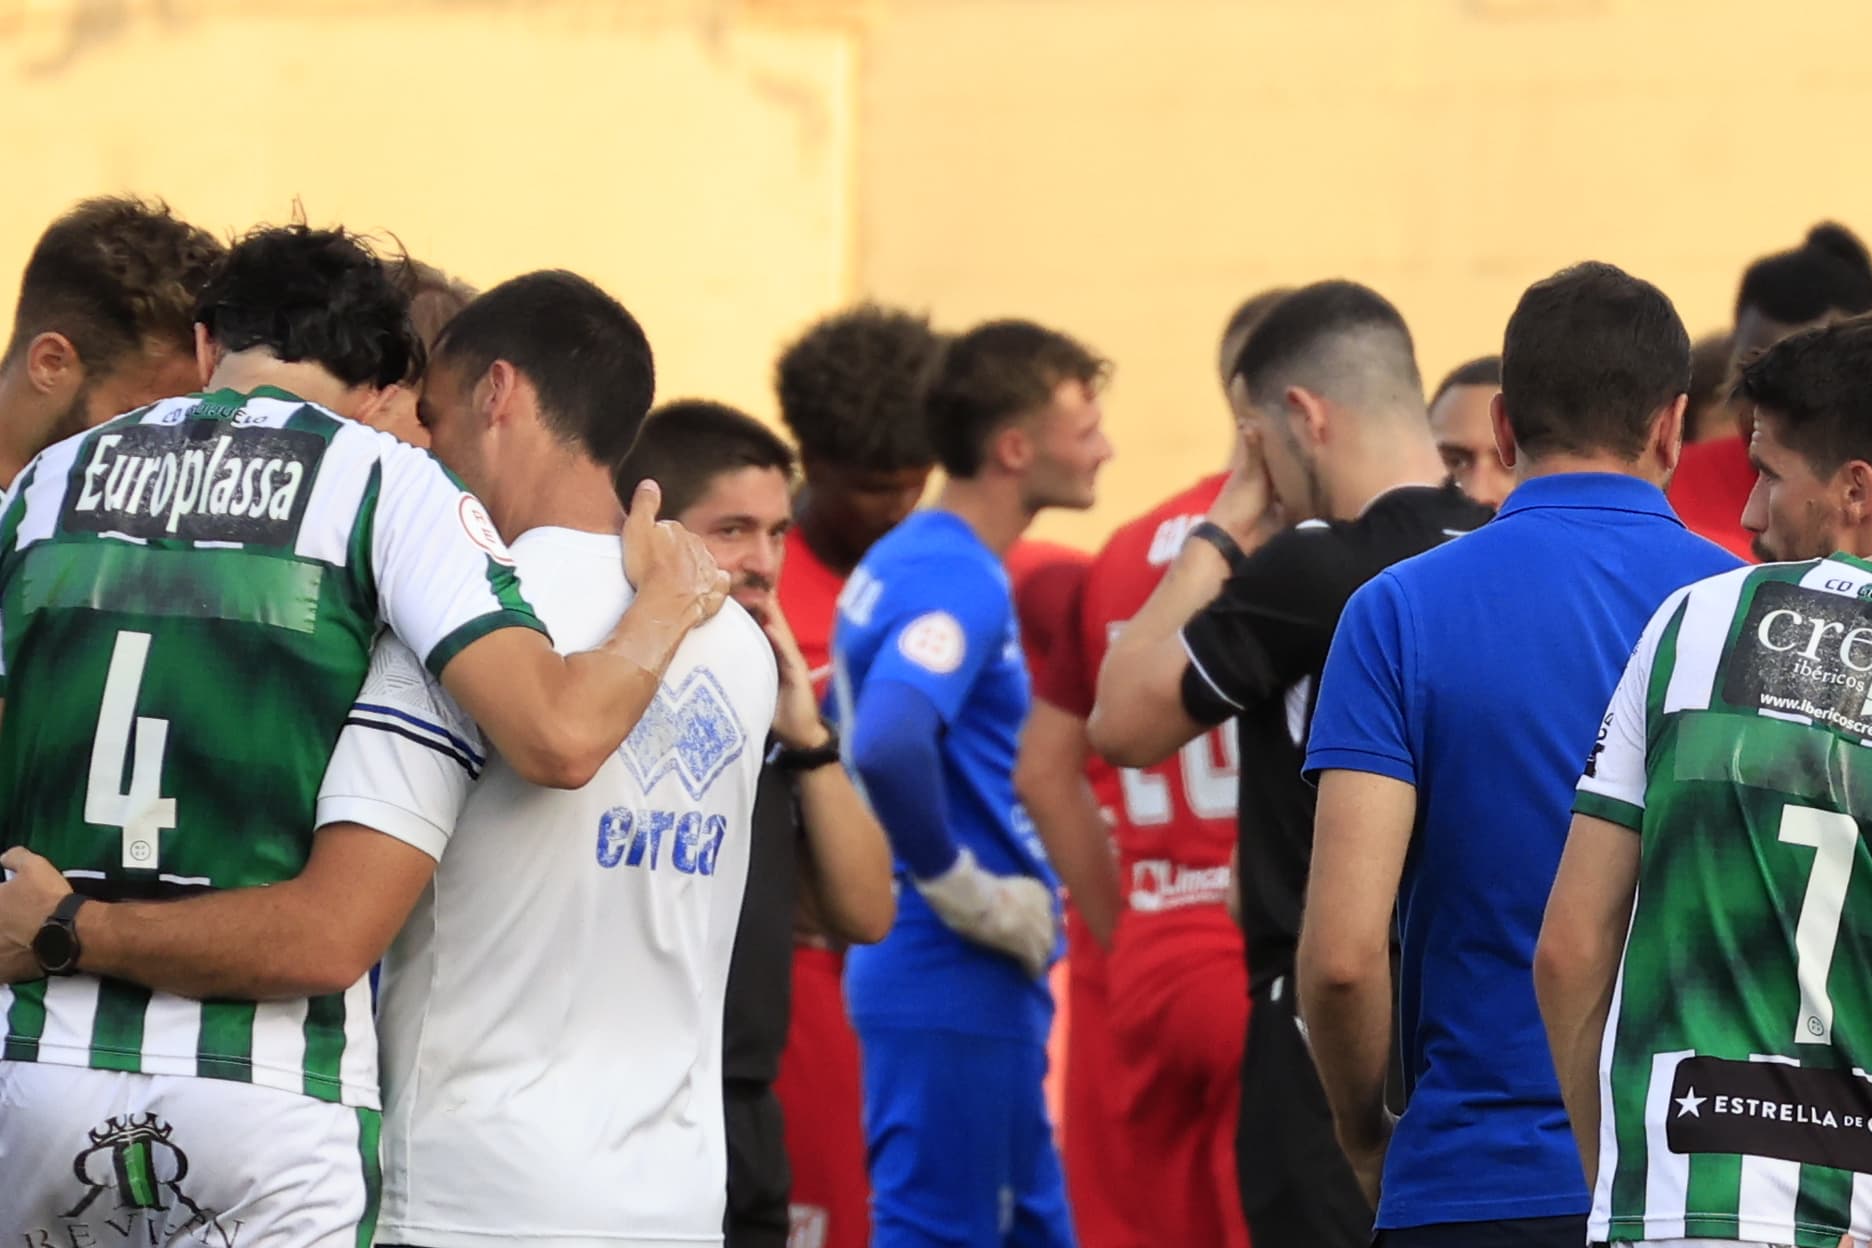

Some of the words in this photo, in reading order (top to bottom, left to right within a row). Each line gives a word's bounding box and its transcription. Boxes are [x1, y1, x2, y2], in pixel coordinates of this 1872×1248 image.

[76, 433, 304, 533] Europlassa
[1825, 578, 1853, 592] CD
[1793, 658, 1866, 693] ibéricos
[84, 630, 176, 869] 4
[596, 806, 728, 876] errea
[1778, 804, 1859, 1046] 7
[1714, 1095, 1839, 1129] ESTRELLA
[1843, 1115, 1863, 1129] DE
